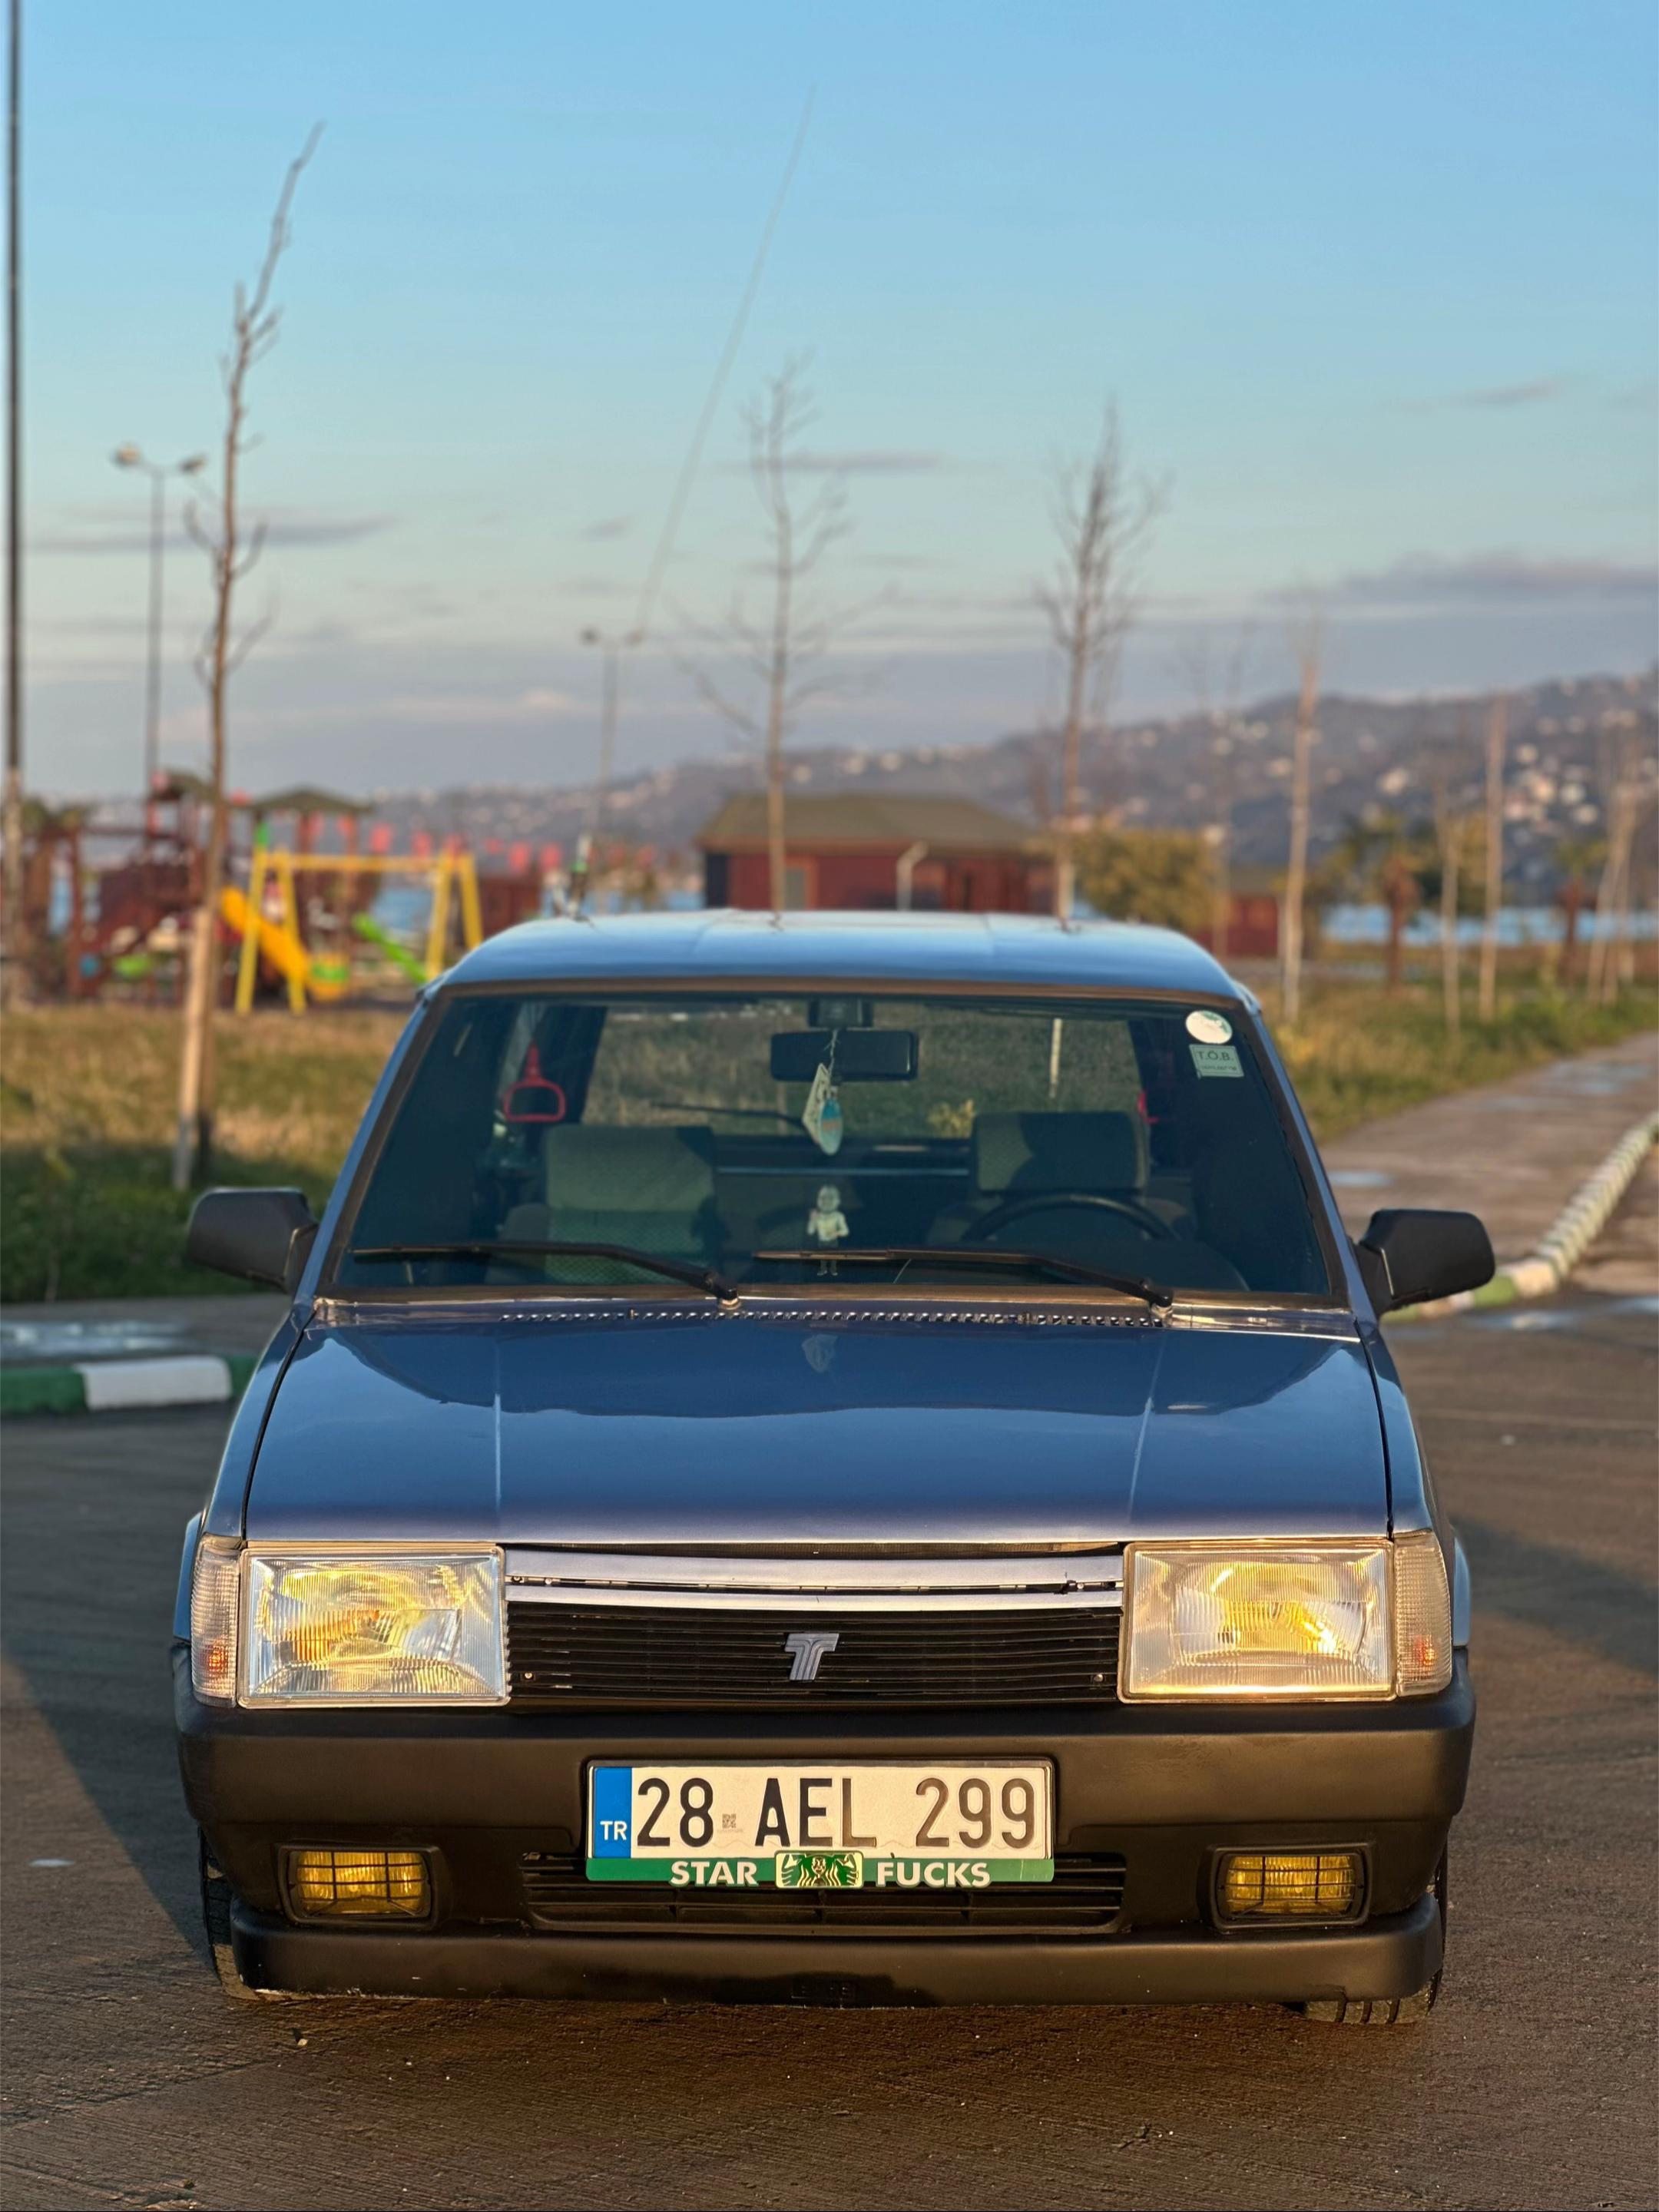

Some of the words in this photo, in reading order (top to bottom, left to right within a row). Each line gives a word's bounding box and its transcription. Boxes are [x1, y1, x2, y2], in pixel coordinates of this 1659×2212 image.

[600, 1821, 628, 1840] TR
[637, 1777, 714, 1847] 28
[754, 1777, 877, 1846] AEL
[916, 1777, 1035, 1849] 299
[671, 1861, 757, 1885] STAR
[877, 1862, 991, 1886] FUCKS
